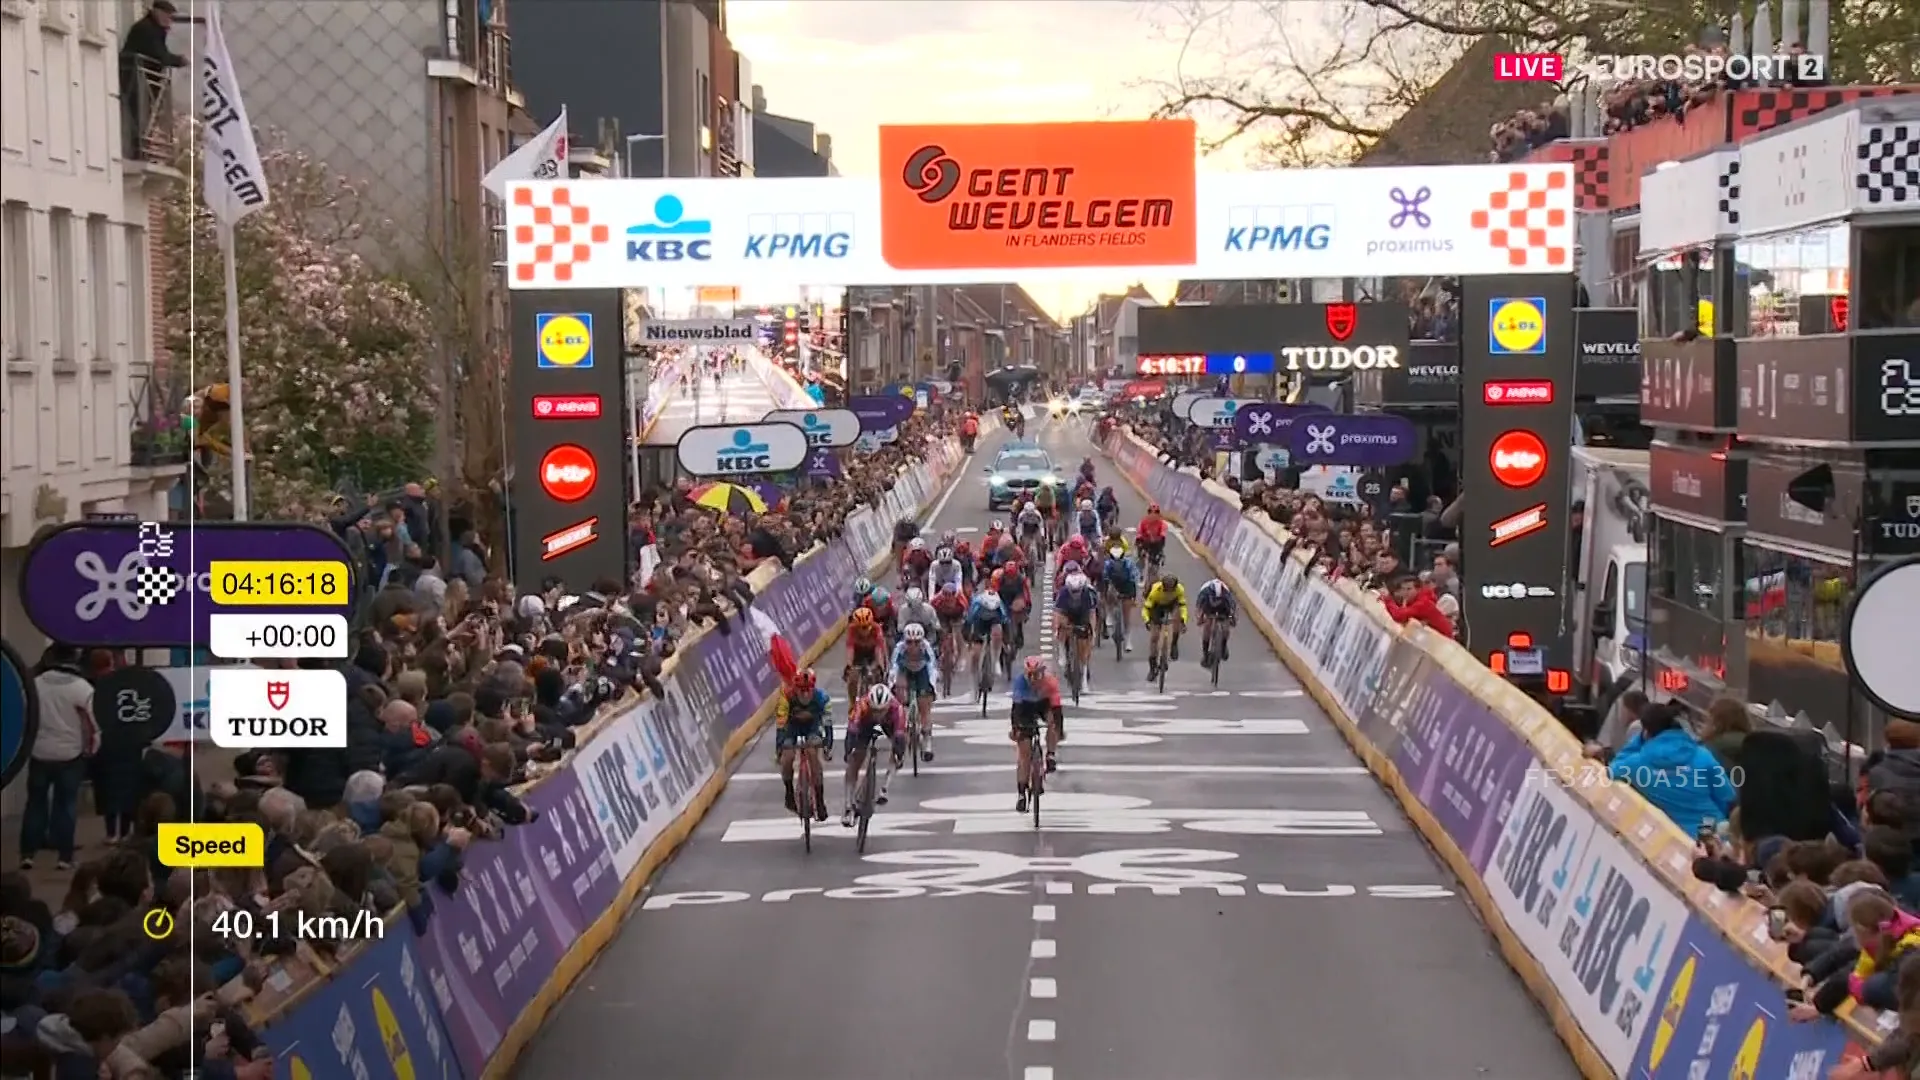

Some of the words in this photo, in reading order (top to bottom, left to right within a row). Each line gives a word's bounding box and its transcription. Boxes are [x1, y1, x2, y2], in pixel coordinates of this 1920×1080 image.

[968, 167, 1074, 196] GENT
[948, 198, 1174, 230] WEVELGEM
[743, 232, 851, 259] KPMG
[1005, 234, 1020, 246] IN
[1023, 233, 1096, 247] FLANDERS
[1099, 232, 1147, 246] FIELDS
[1224, 223, 1332, 252] KPMG
[1366, 237, 1454, 256] proximus
[626, 239, 712, 261] KBC
[646, 323, 753, 341] Nieuwsblad
[1233, 356, 1246, 373] 0
[1281, 345, 1401, 371] TUDOR
[1340, 433, 1398, 445] proximus
[716, 455, 771, 471] KBC
[1365, 483, 1381, 495] 25
[642, 882, 1456, 910] proximus
